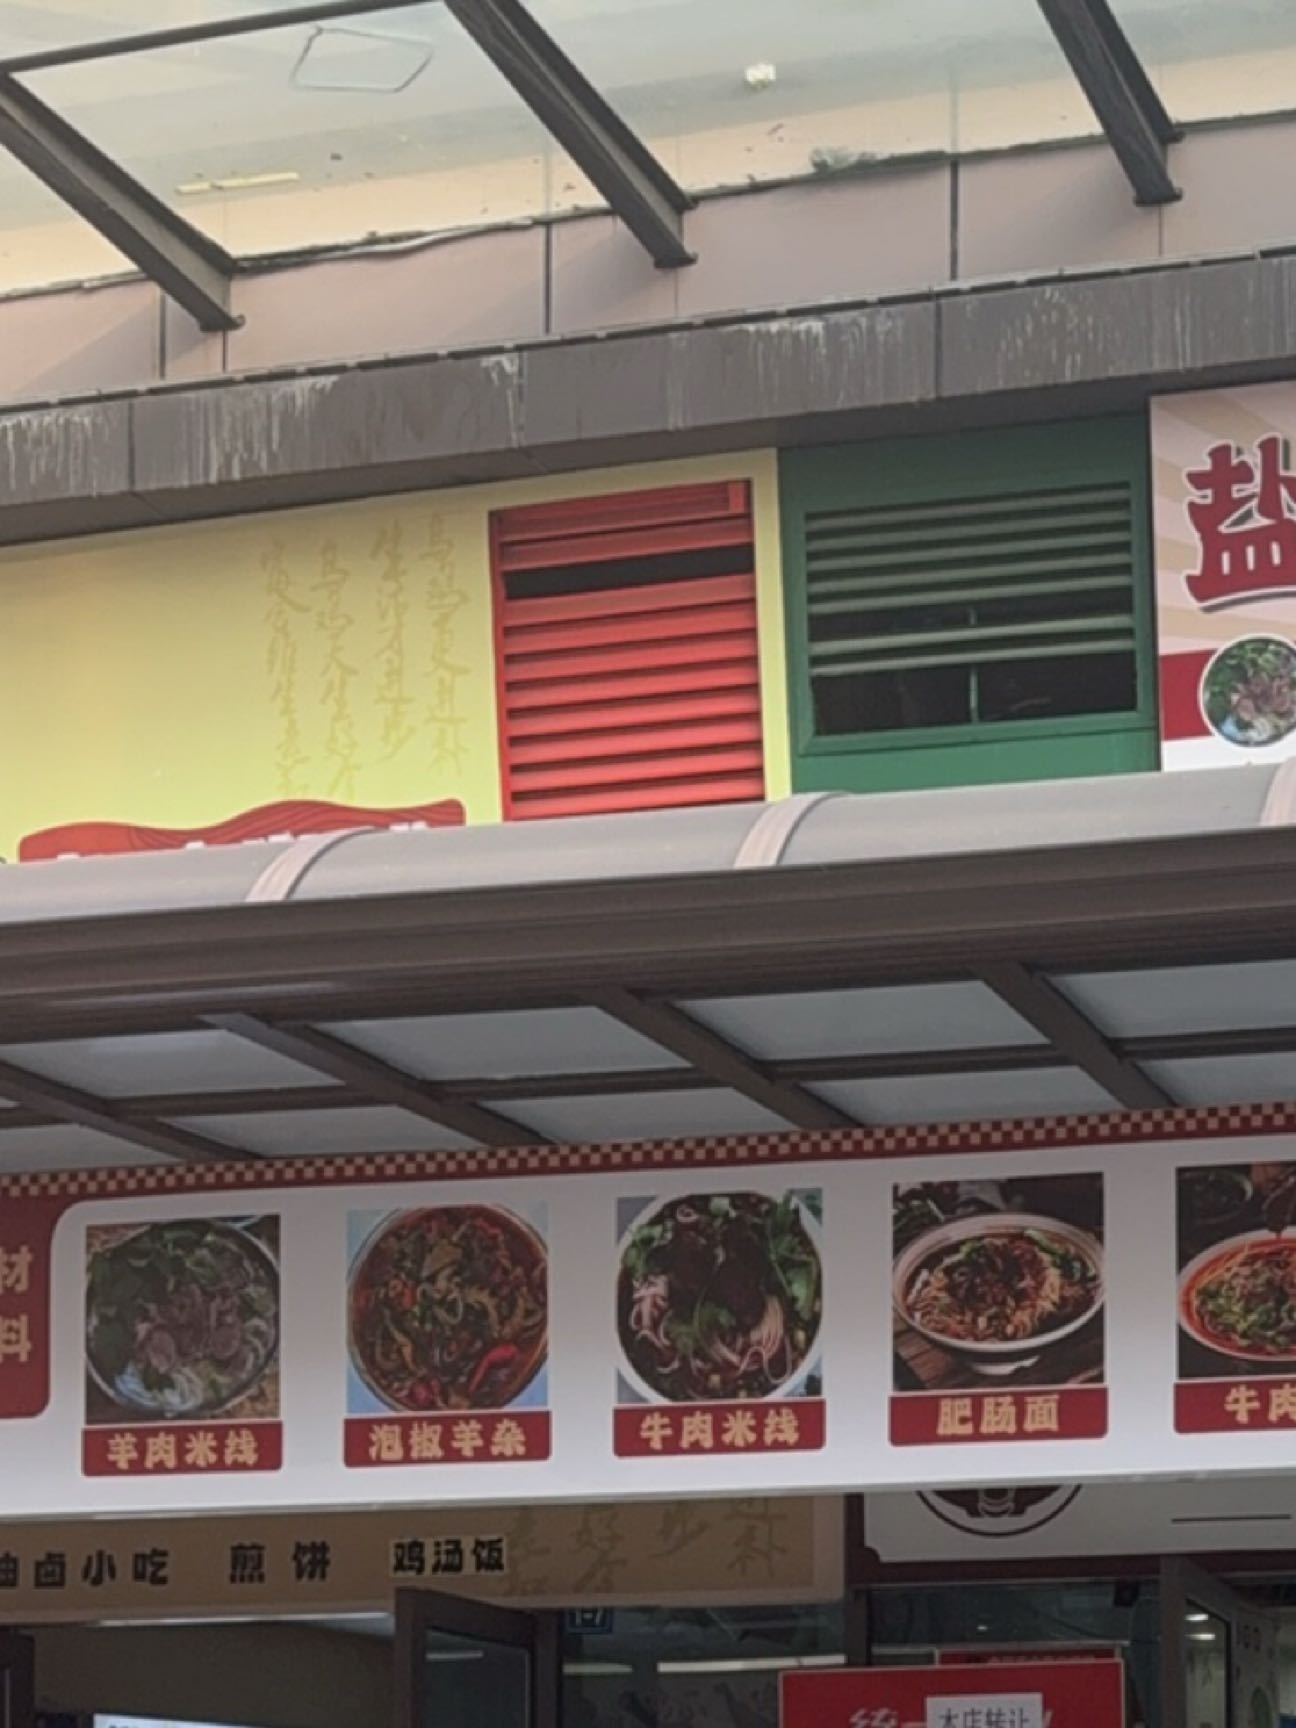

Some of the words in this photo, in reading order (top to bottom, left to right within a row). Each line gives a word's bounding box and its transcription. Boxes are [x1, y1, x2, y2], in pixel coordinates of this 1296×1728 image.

[640, 1410, 801, 1450] 牛肉米线
[936, 1395, 1060, 1436] 肥肠面
[107, 1429, 259, 1471] 羊肉米线
[369, 1419, 526, 1461] 泡椒羊杂
[229, 1541, 330, 1584] 煎饼
